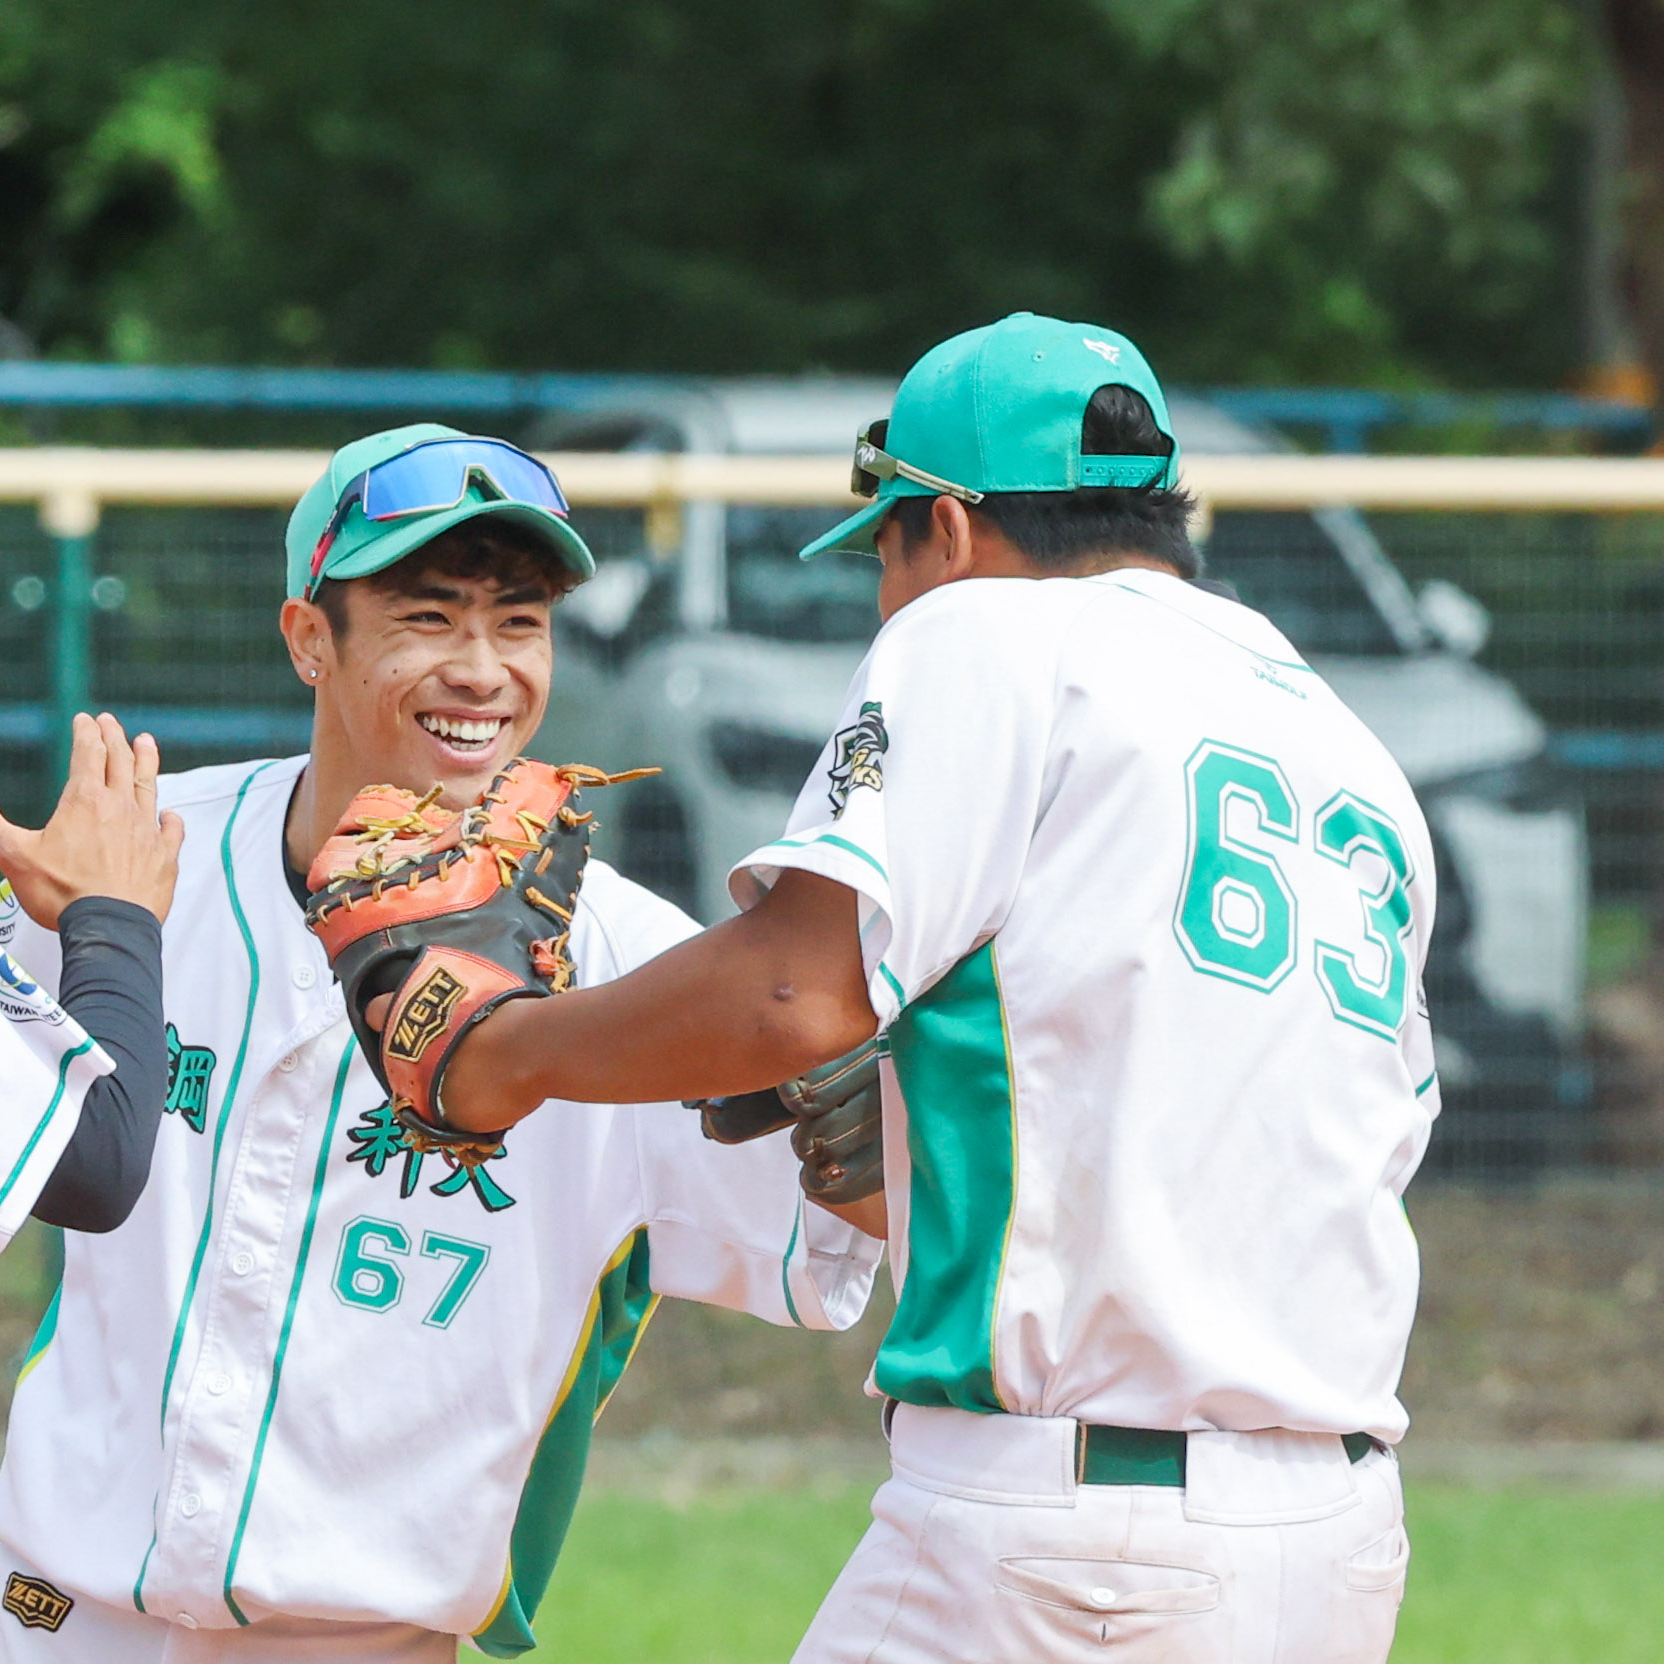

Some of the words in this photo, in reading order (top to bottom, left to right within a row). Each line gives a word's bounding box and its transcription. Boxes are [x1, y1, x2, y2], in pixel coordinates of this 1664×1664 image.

[1172, 737, 1417, 1045] 63
[394, 970, 454, 1051] ZETT
[331, 1214, 491, 1331] 67
[7, 1581, 66, 1618] ZETT
